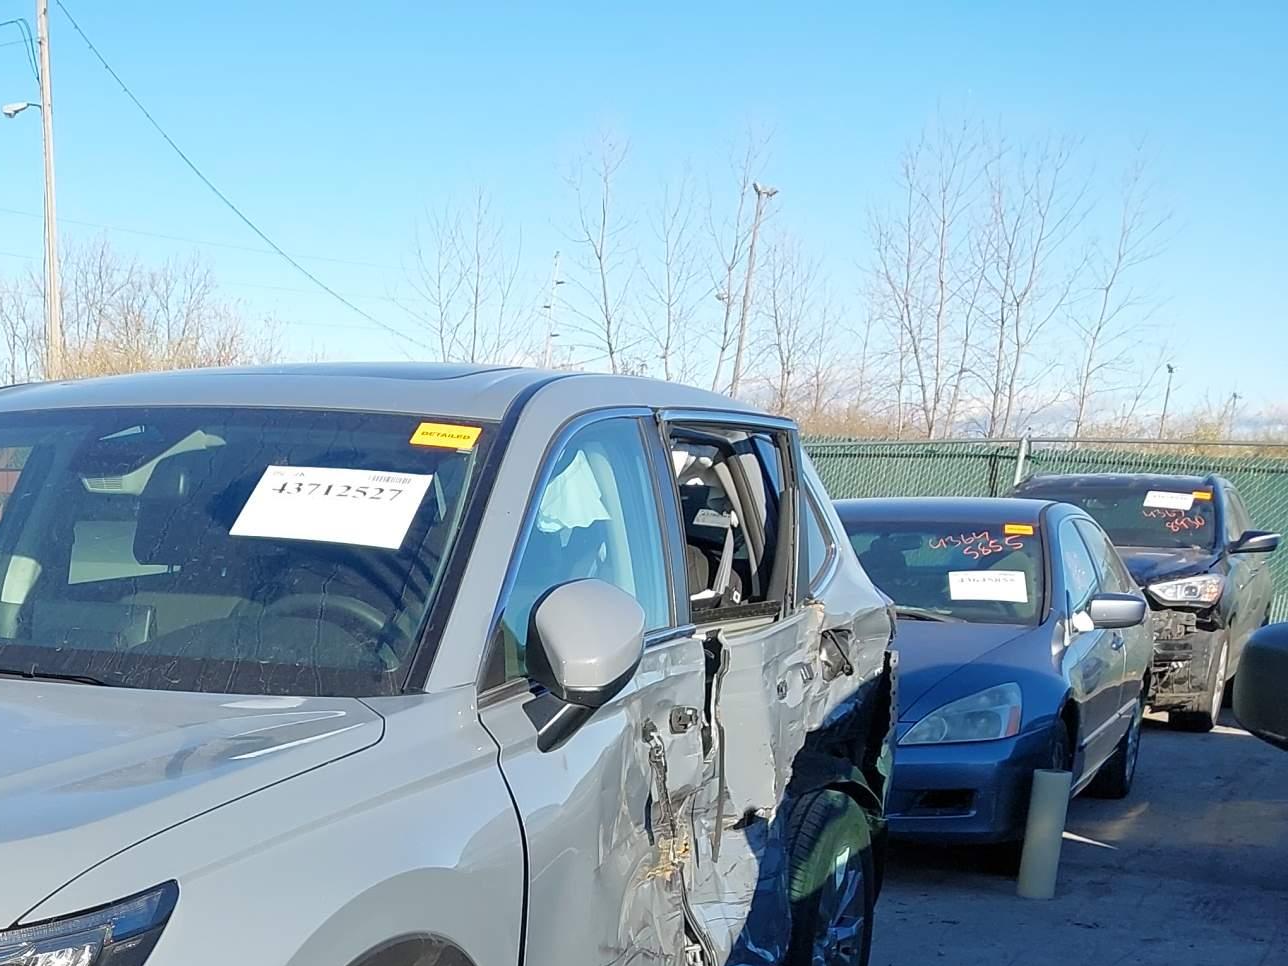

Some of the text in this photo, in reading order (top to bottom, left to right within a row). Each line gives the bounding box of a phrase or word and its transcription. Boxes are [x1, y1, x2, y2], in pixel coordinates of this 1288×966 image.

[420, 430, 471, 440] DETAILED
[271, 481, 403, 502] 43712527
[928, 530, 991, 550] 4364
[963, 535, 1024, 560] 5855
